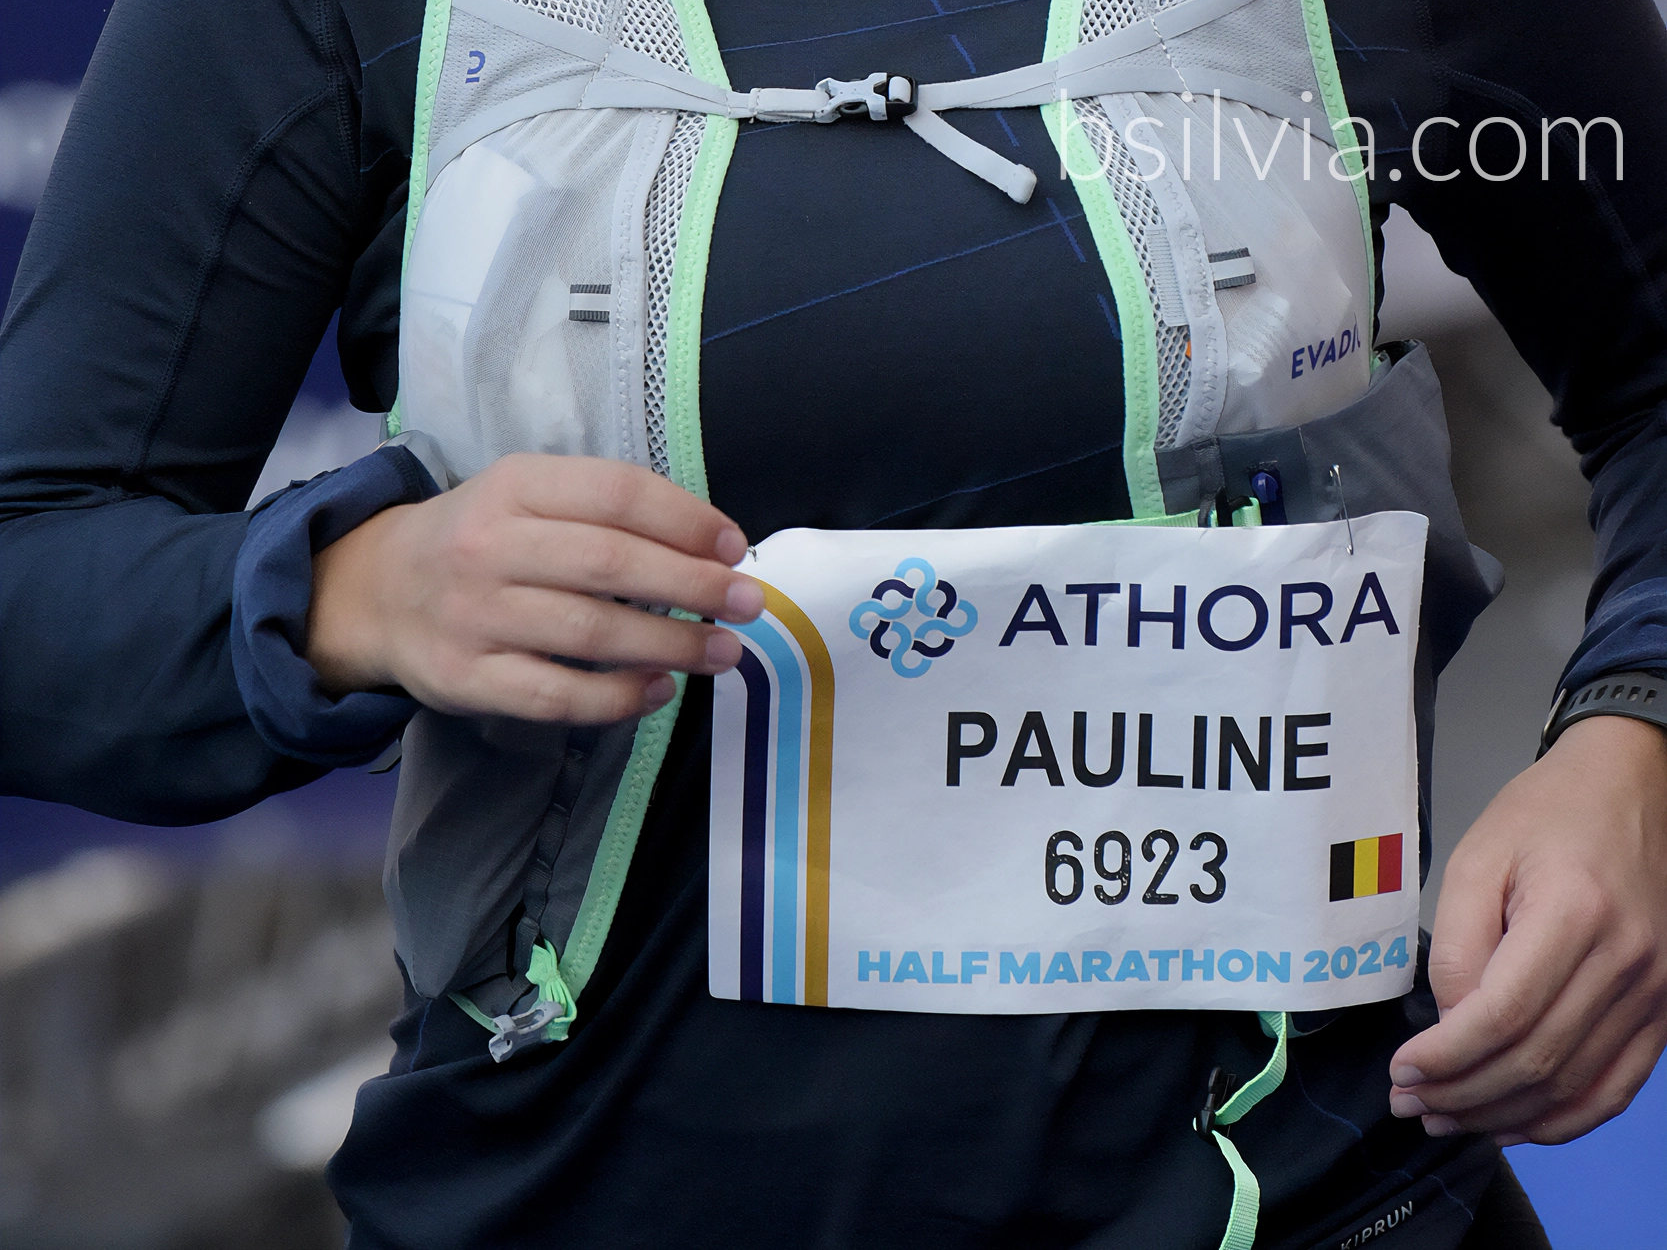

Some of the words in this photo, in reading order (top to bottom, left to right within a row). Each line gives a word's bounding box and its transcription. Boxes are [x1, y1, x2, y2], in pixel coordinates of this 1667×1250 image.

[998, 571, 1401, 652] ATHORA
[945, 711, 1332, 792] PAULINE
[1044, 829, 1229, 905] 6923
[857, 950, 989, 985] HALF
[999, 948, 1292, 985] MARATHON
[1302, 936, 1410, 982] 2024
